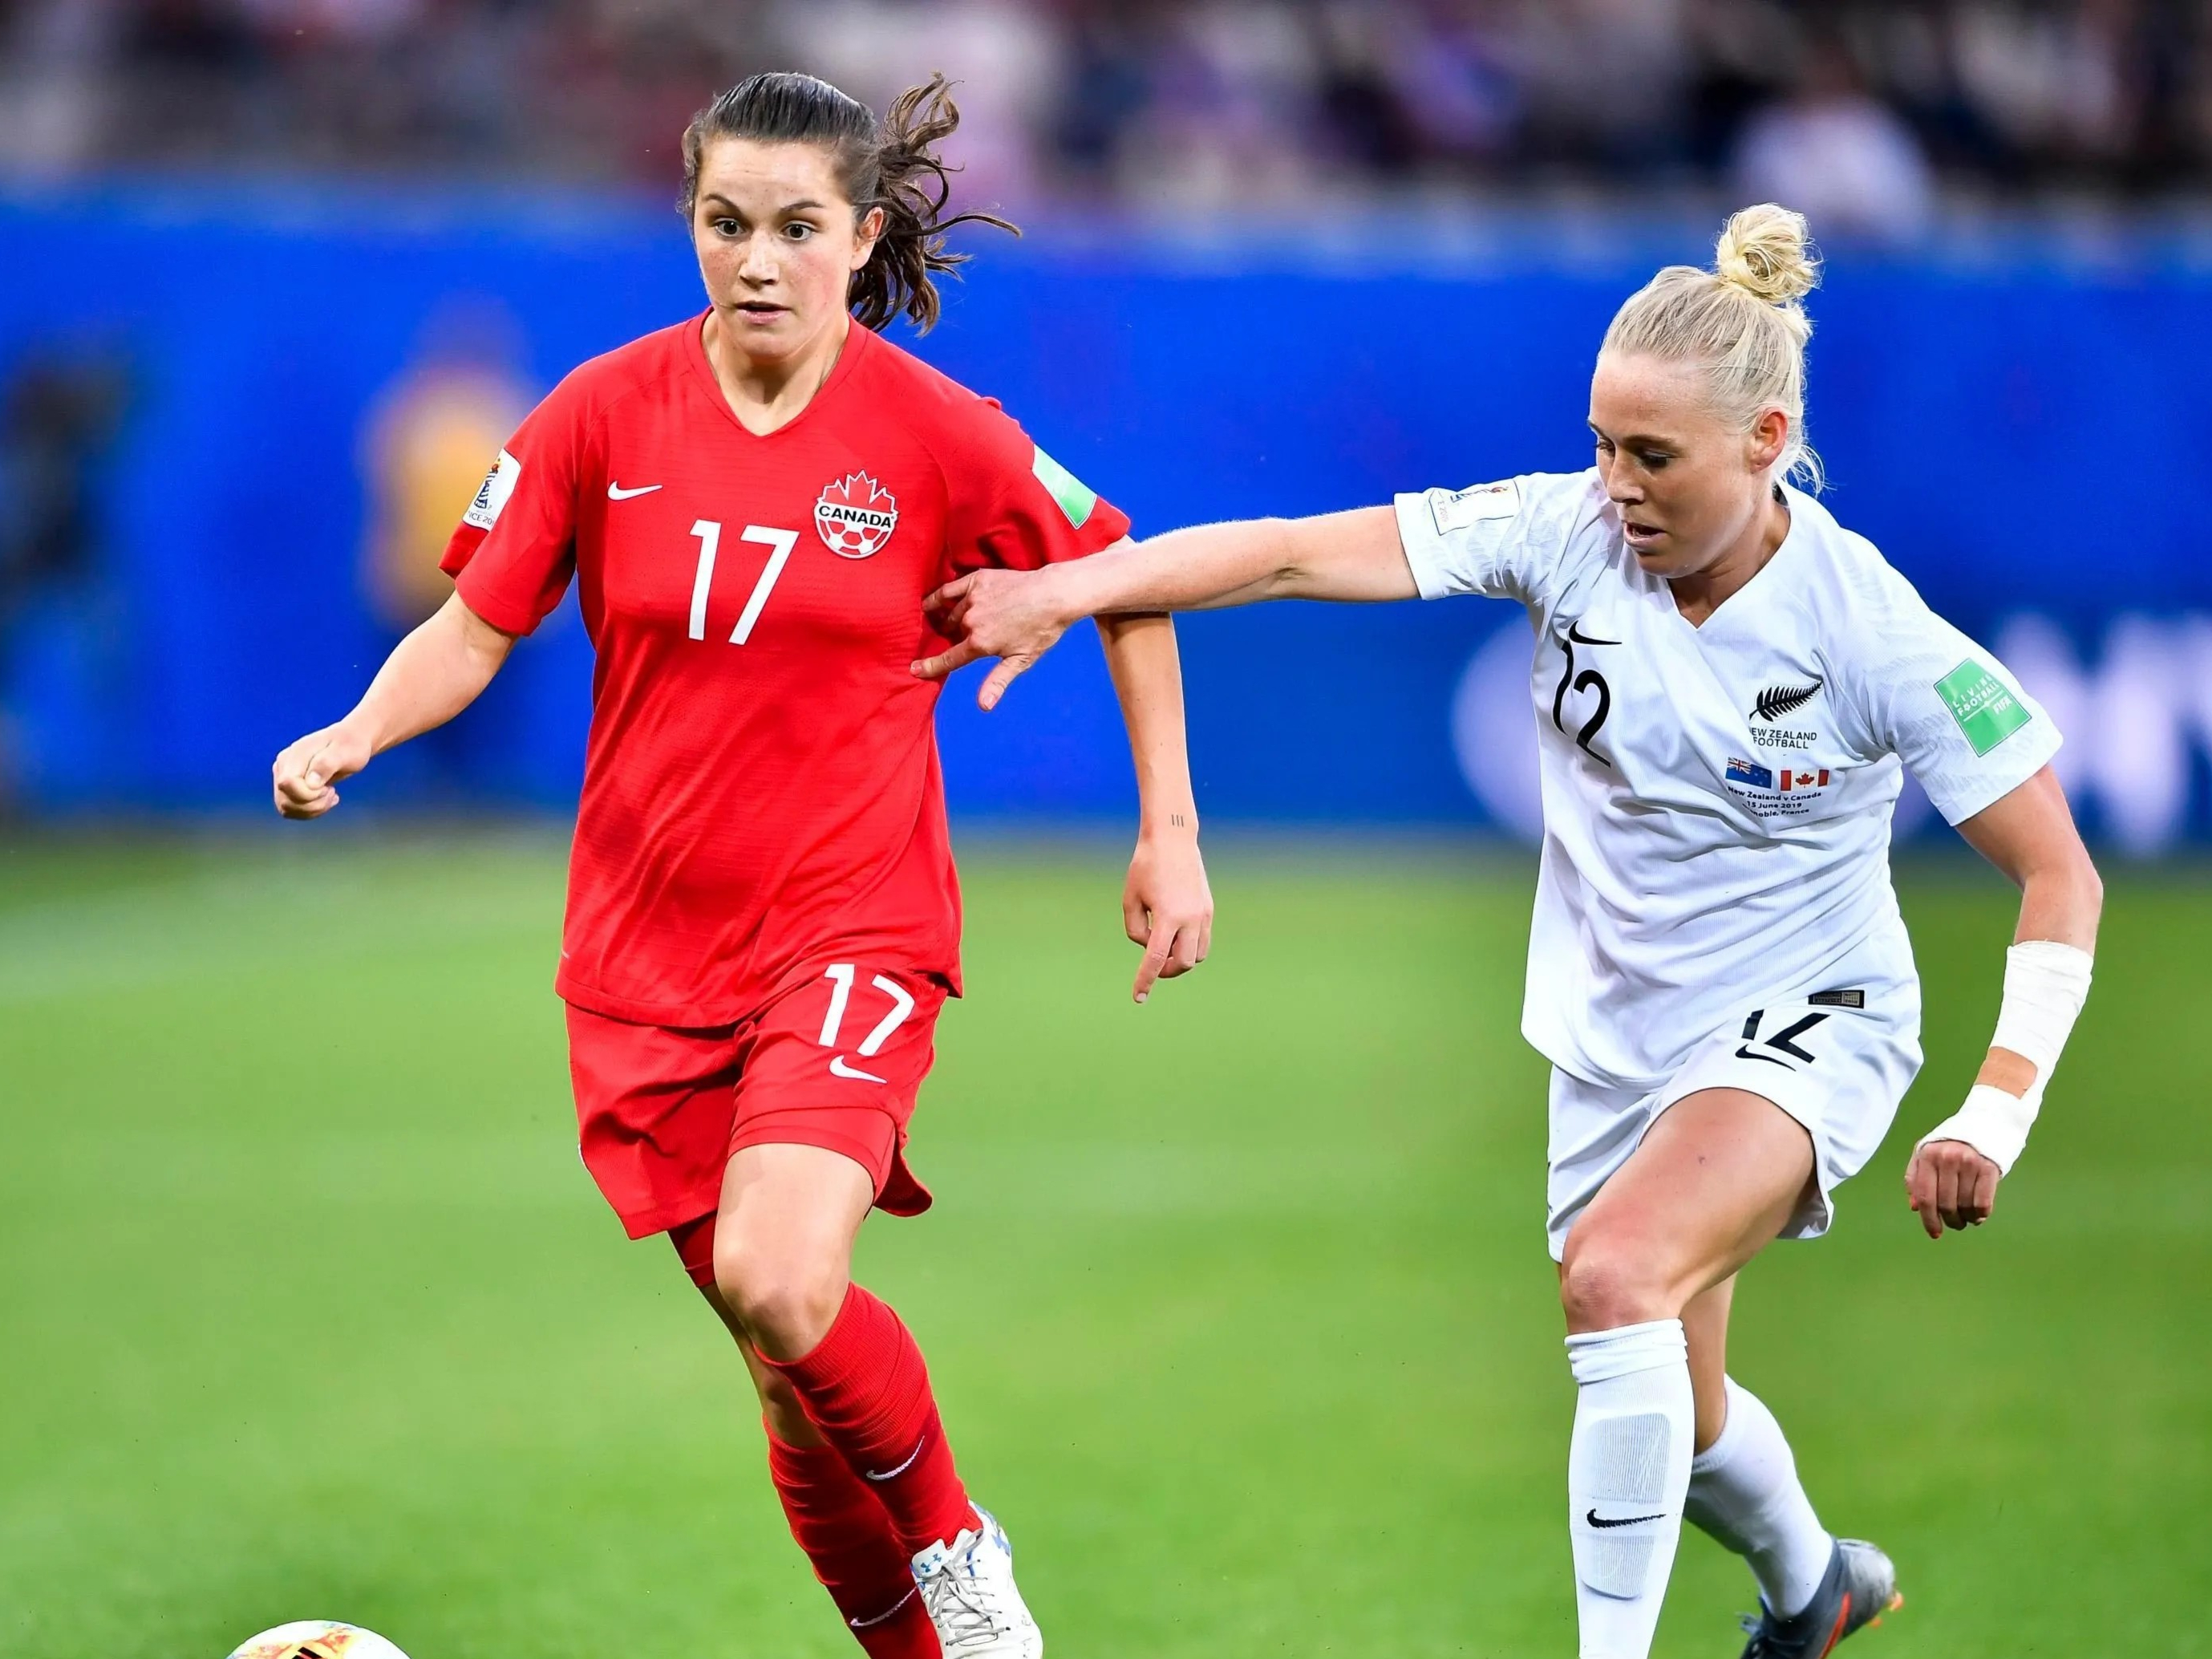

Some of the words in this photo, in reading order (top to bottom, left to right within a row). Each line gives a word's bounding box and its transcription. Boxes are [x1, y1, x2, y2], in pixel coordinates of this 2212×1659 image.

[818, 505, 892, 529] CANADA
[688, 519, 800, 646] 17
[1553, 641, 1611, 769] 12
[1992, 695, 2013, 716] FIFA
[1753, 736, 1809, 749] FOOTBALL
[1769, 729, 1817, 741] ZEALAND
[1728, 786, 1745, 797] New
[1747, 791, 1781, 801] Zealand
[1790, 791, 1822, 801] Canada
[818, 963, 915, 1057] 17
